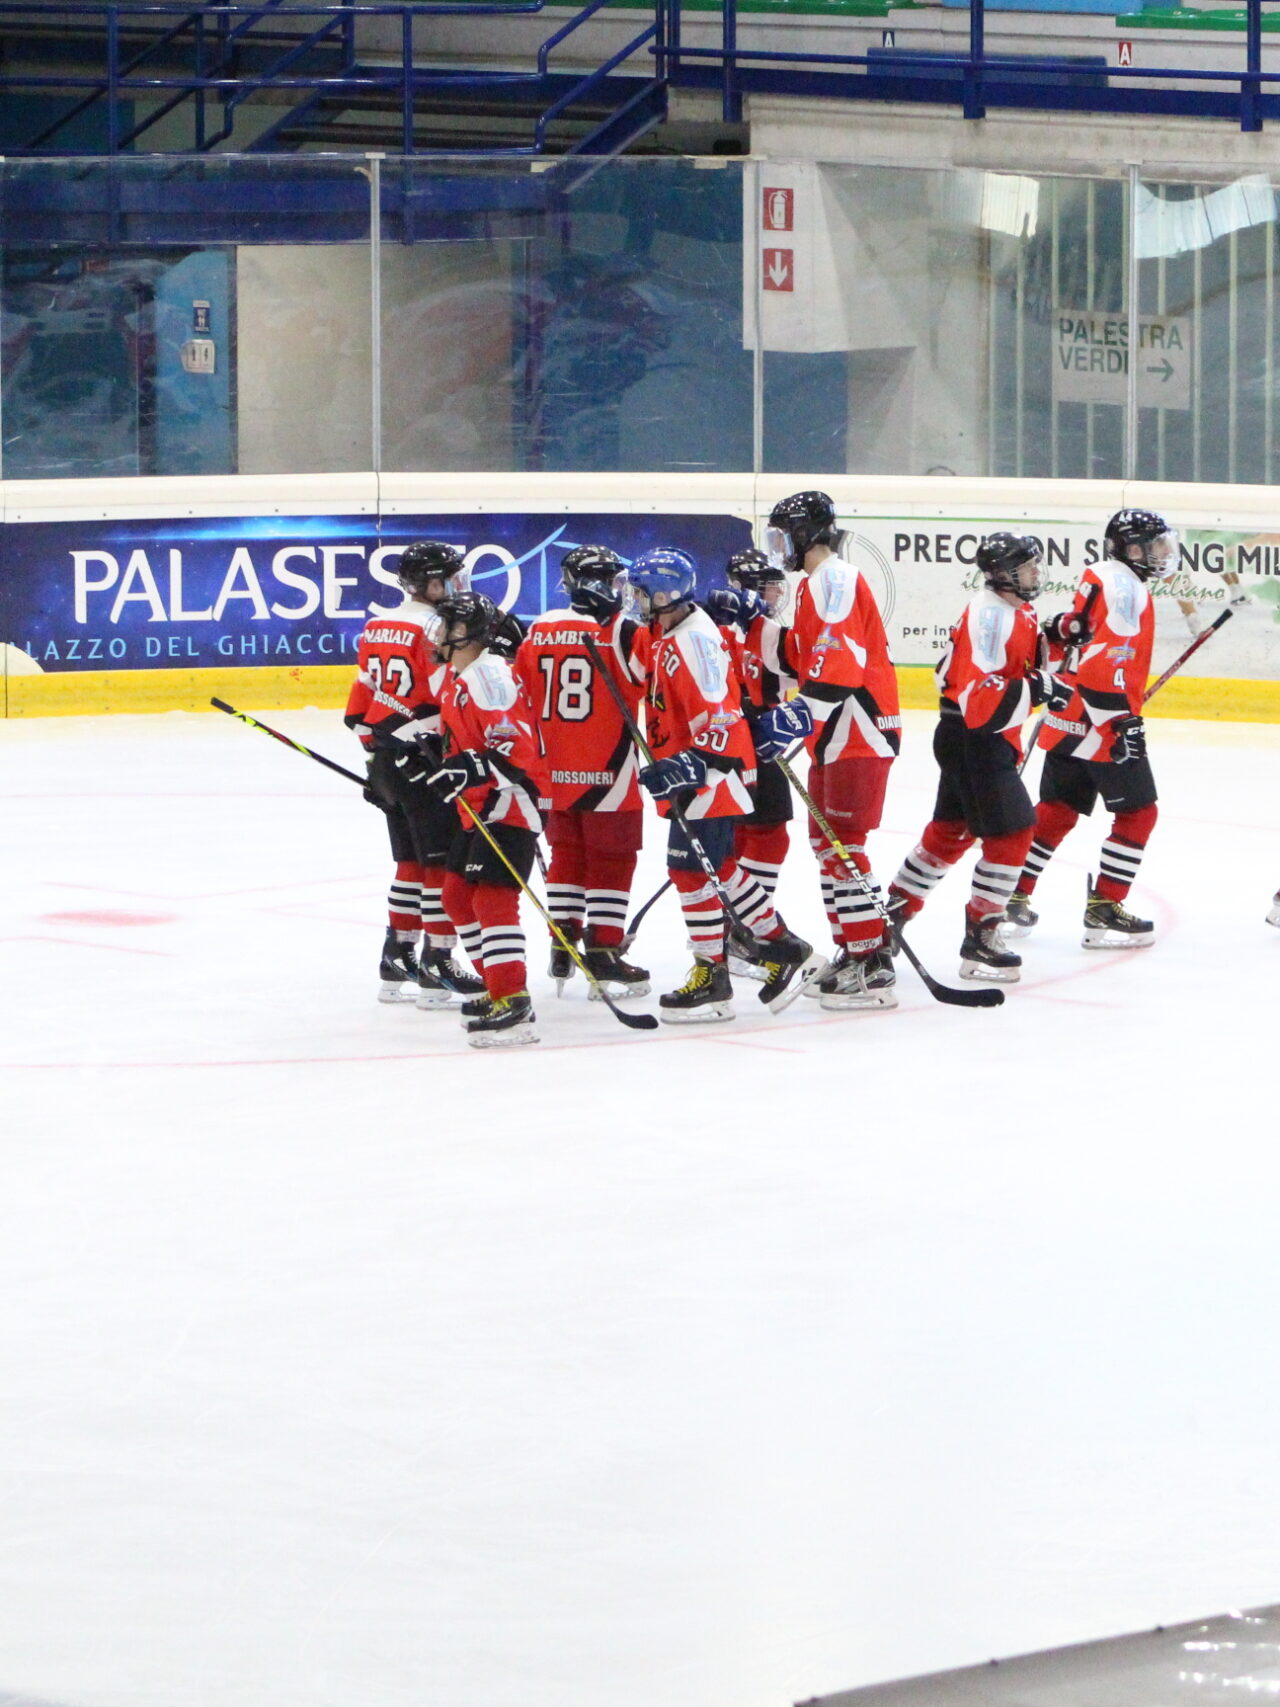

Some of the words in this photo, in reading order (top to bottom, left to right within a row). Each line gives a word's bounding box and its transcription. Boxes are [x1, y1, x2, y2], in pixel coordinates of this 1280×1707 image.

[69, 542, 522, 625] PALASESO
[903, 624, 928, 639] per
[145, 635, 200, 658] DEL
[539, 656, 592, 722] 18
[1113, 667, 1126, 691] 4
[551, 769, 614, 786] ROSSONERI
